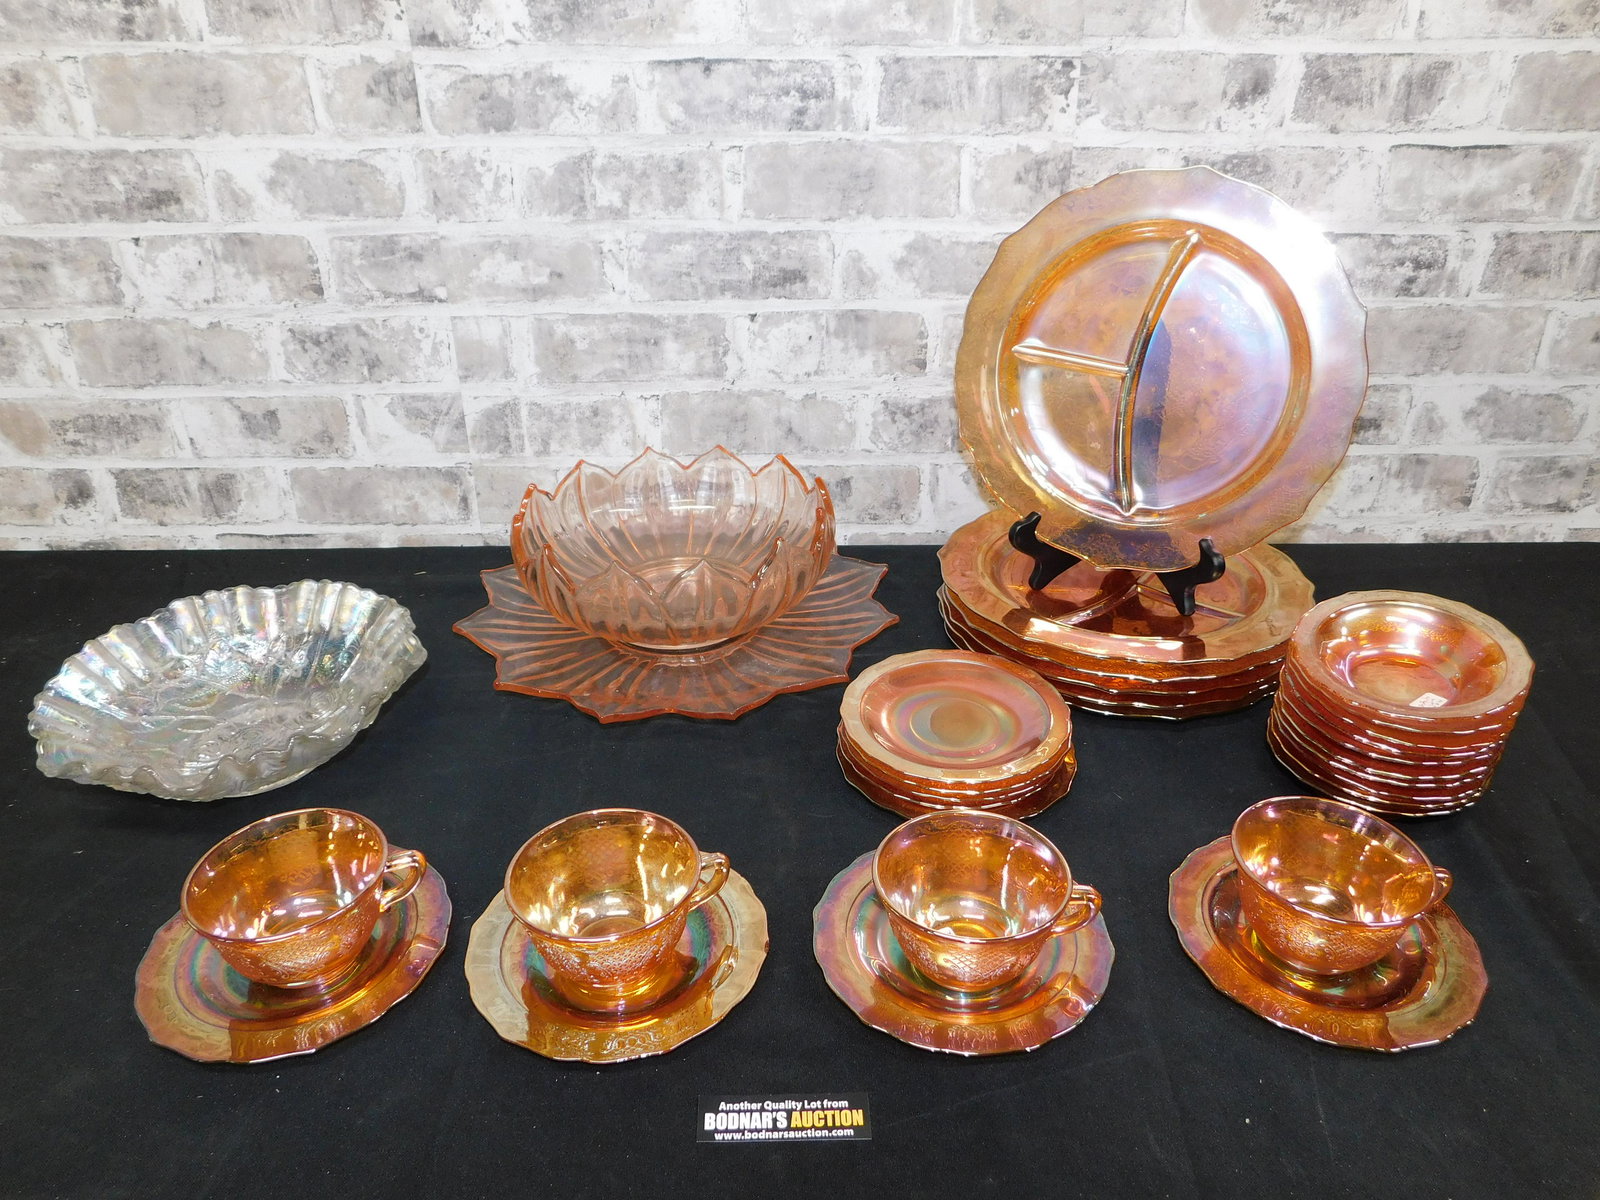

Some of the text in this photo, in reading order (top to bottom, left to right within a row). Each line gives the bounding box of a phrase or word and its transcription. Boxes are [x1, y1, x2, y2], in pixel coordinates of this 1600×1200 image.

[719, 1099, 848, 1111] Another Quality Lot from
[704, 1109, 864, 1130] BODNAR'S AUCTION
[714, 1128, 854, 1140] www.bodnarsauction.com
